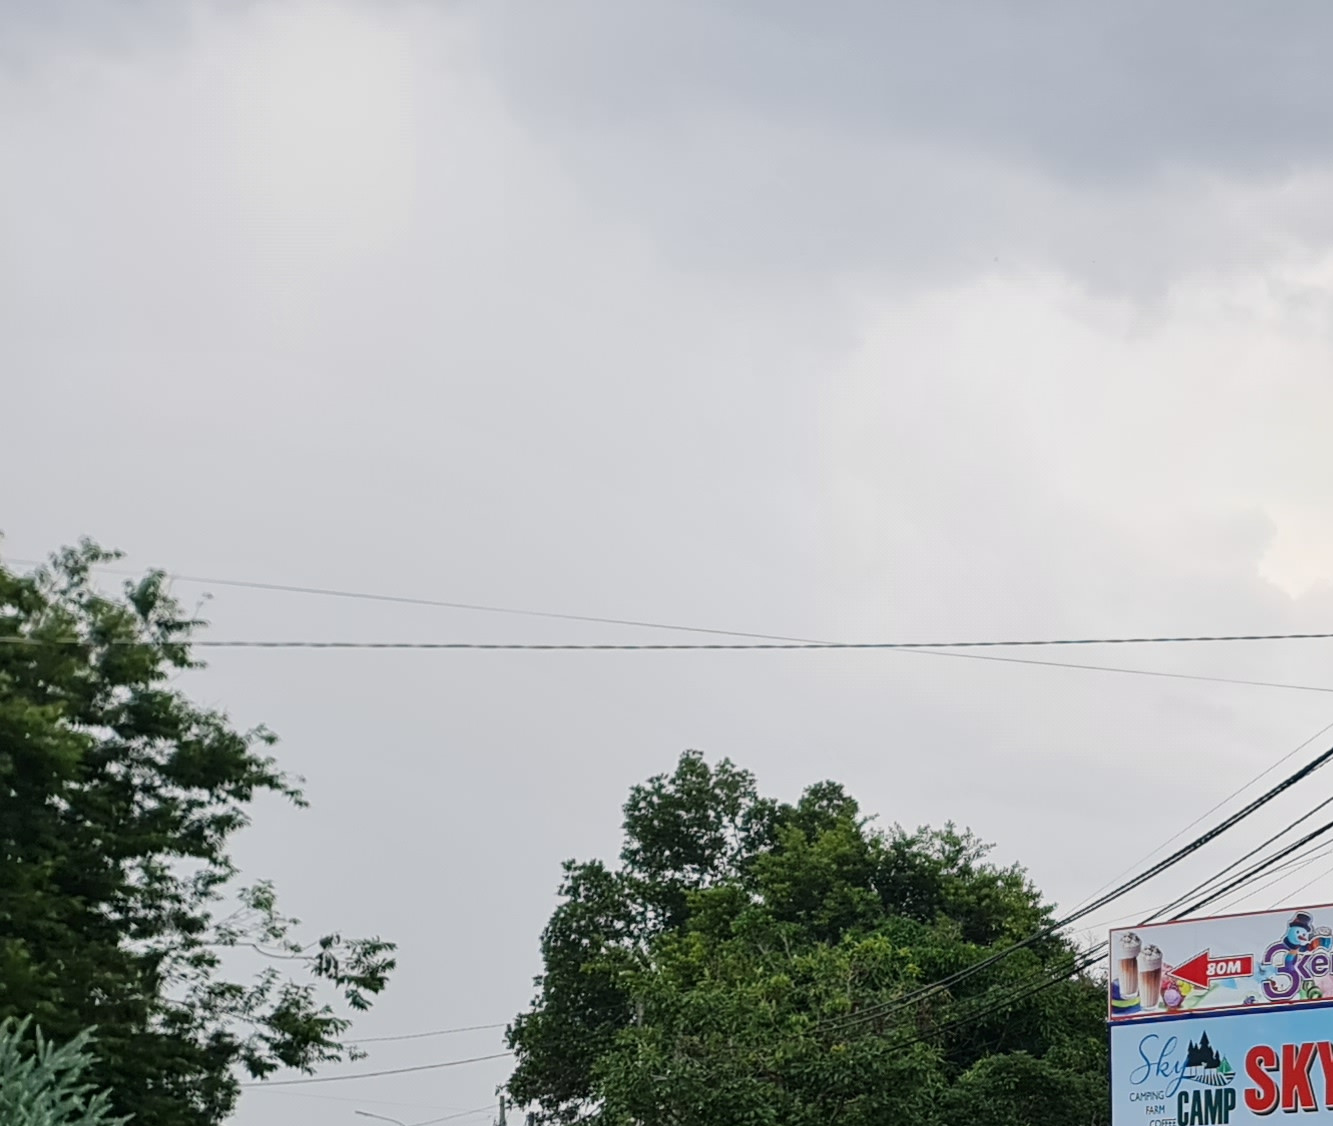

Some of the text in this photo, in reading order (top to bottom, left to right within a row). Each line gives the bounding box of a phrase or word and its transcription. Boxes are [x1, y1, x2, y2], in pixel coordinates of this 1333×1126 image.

[1206, 959, 1242, 976] 80M
[1129, 1033, 1190, 1098] Sky
[1129, 1091, 1165, 1102] CAMPING
[1145, 1105, 1166, 1116] FARM
[1177, 1087, 1237, 1126] CAMP
